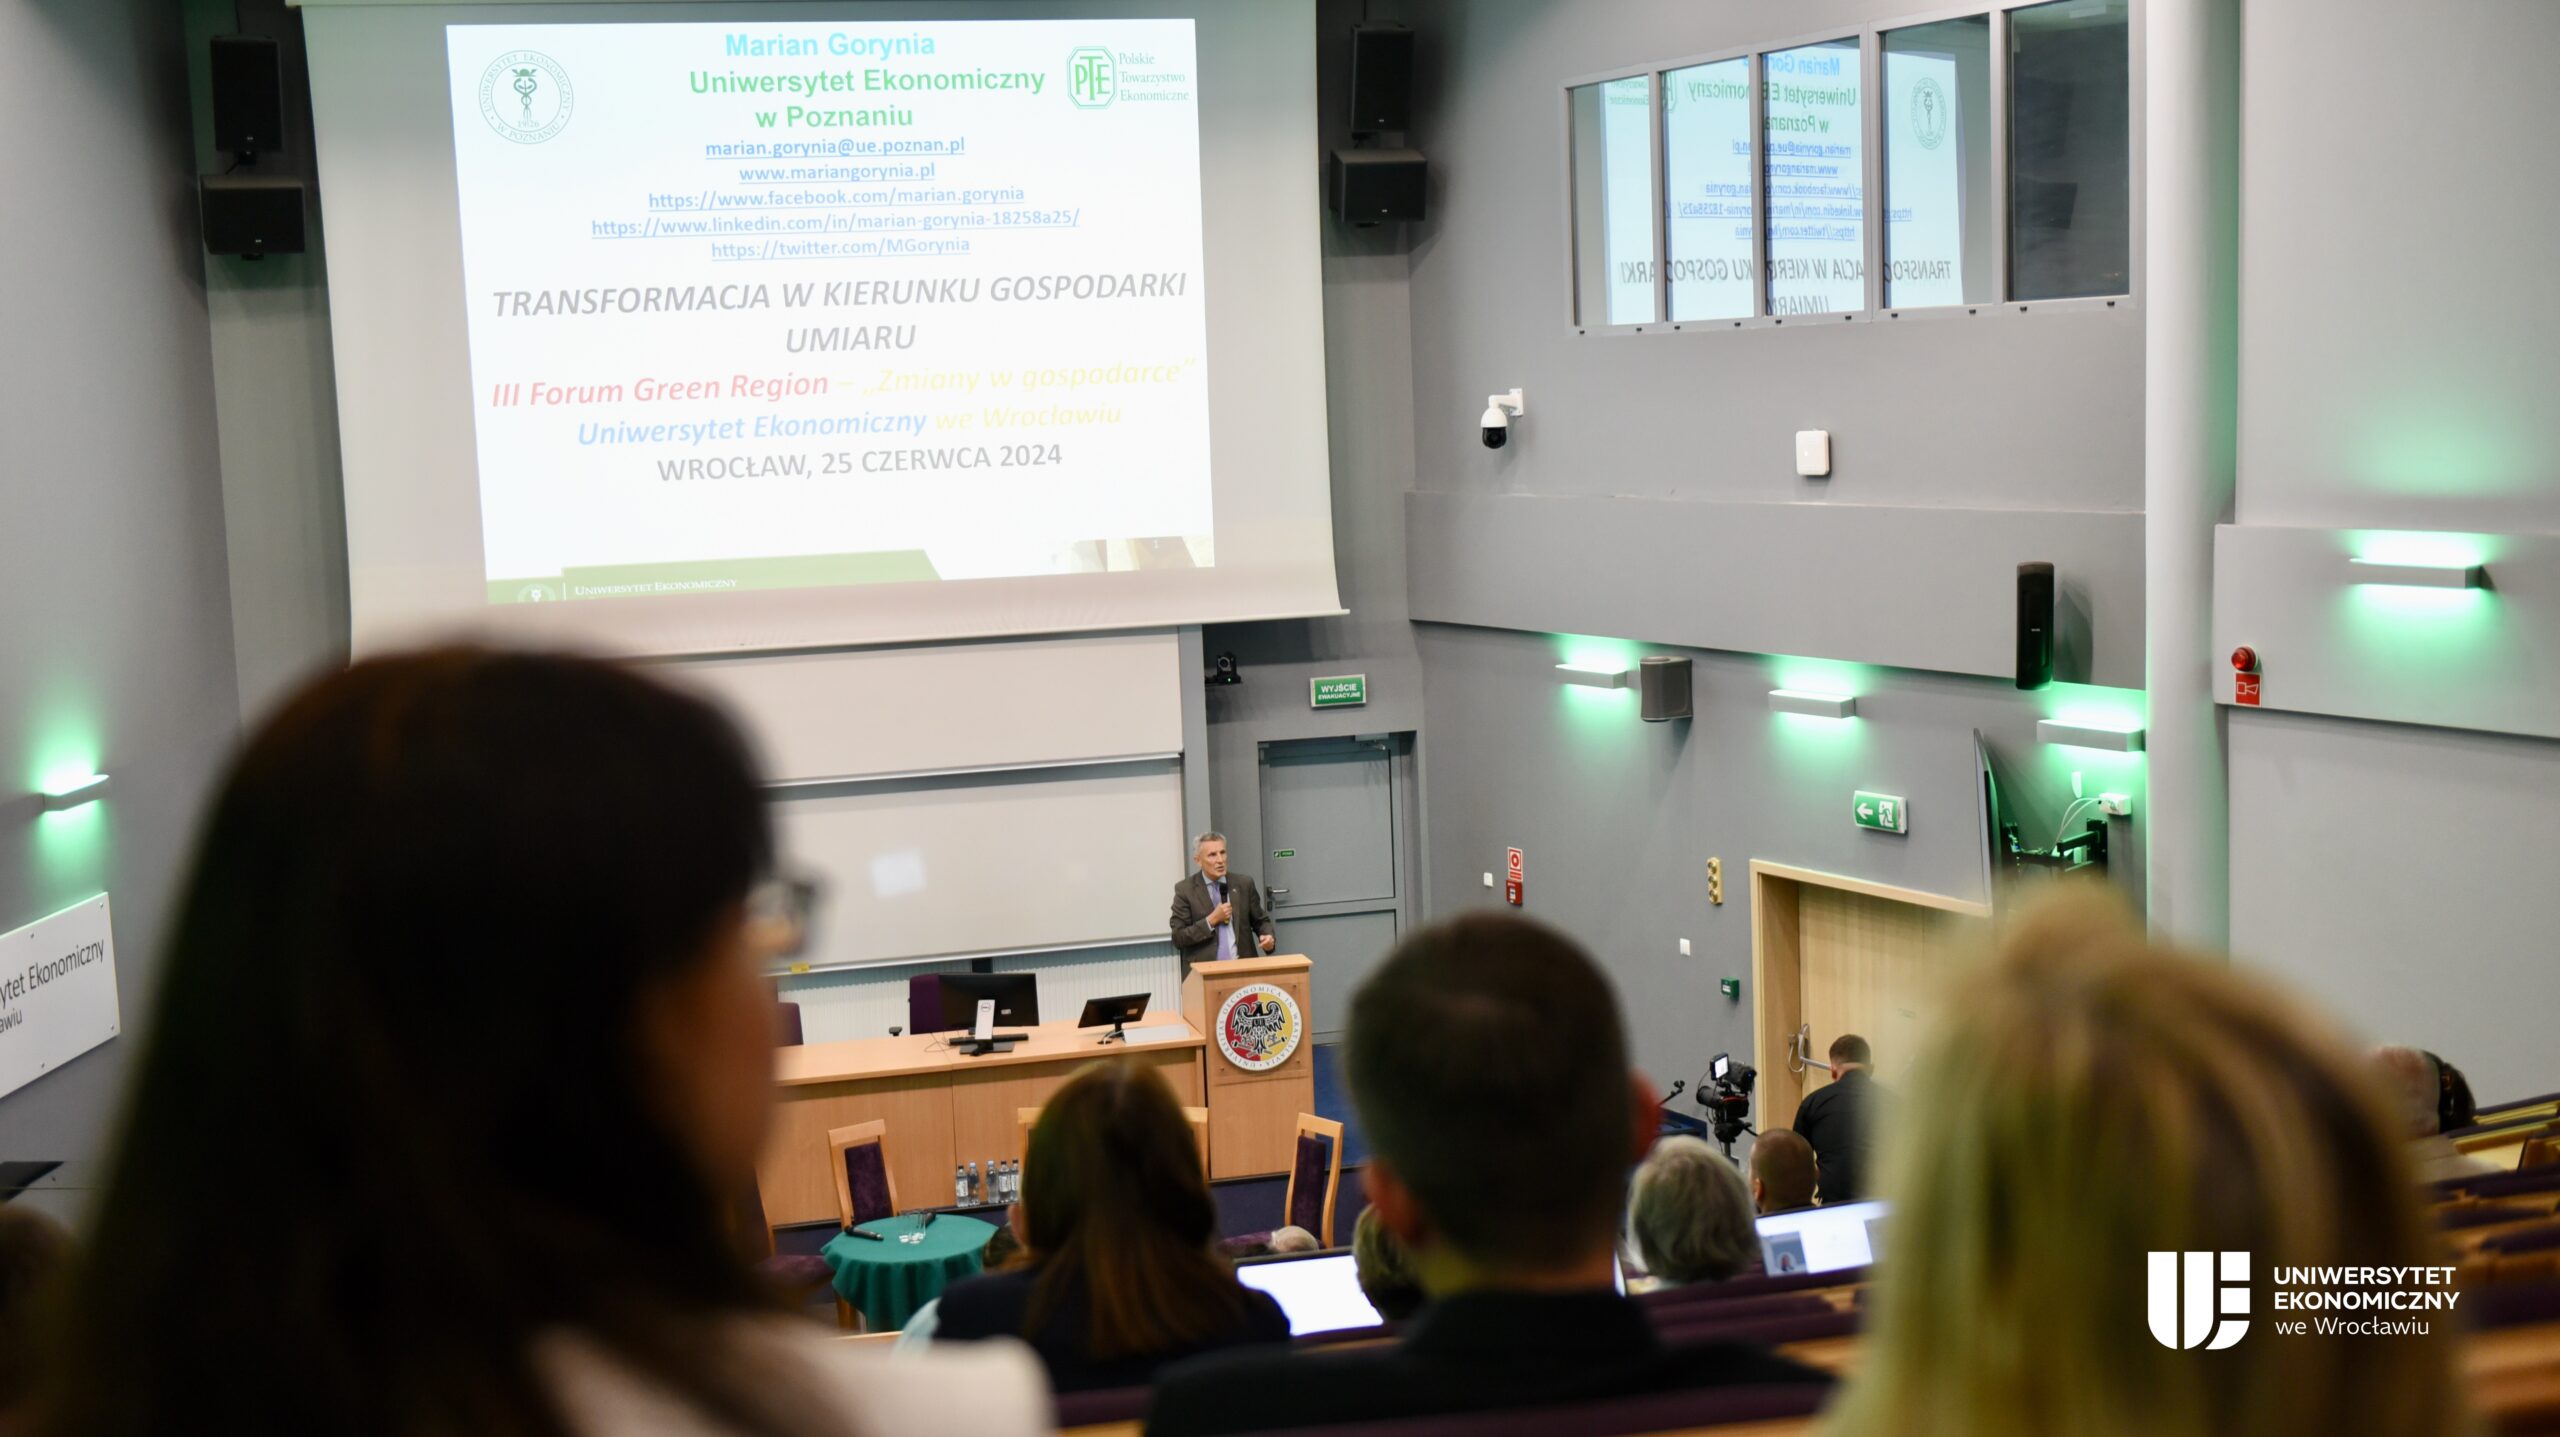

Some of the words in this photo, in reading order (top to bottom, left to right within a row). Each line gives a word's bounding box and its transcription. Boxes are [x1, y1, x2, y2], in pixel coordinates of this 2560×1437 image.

[725, 33, 818, 57] Marian
[828, 32, 936, 61] Gorynia
[1119, 52, 1155, 66] Polskie
[690, 69, 854, 98] Uniwersytet
[864, 67, 1046, 94] Ekonomiczny
[1075, 56, 1110, 101] PTE
[1119, 70, 1186, 87] Towarzystwo
[1120, 89, 1189, 102] Ekonomiczne
[755, 112, 777, 128] w
[787, 105, 913, 128] Poznaniu
[705, 136, 966, 159] marian.gorynia@ue.poznan.pl
[739, 162, 936, 183] www.mariangorynia.pl
[648, 187, 1025, 211] https://www.facebook.com/marian.gorynia
[591, 208, 1081, 239] https://www.linkedin.com/in/marian-gorynia-18258a25/
[711, 236, 971, 261] https://twitter.com/MGorynia
[493, 284, 771, 317] TRANSFORMACJA
[782, 282, 815, 308] W
[824, 278, 981, 306] KIERUNKU
[990, 272, 1187, 302] GOSPODARKI
[785, 324, 916, 353] UMIARU
[492, 384, 520, 407] III
[530, 381, 623, 405] Forum
[633, 377, 720, 401] Green
[730, 372, 829, 402] Region
[989, 373, 1012, 389] w
[578, 417, 745, 447] Uniwersytet
[754, 411, 927, 437] Ekonomiczny
[935, 413, 973, 430] we
[982, 402, 1122, 430] Wrocławiu
[657, 454, 813, 481] WROCŁAW,
[822, 452, 853, 475] 25
[861, 447, 992, 472] CZERWCA
[1000, 444, 1063, 467] 2024
[1321, 682, 1357, 693] WYJŚCIE
[29, 939, 104, 990] Ekonomiczny
